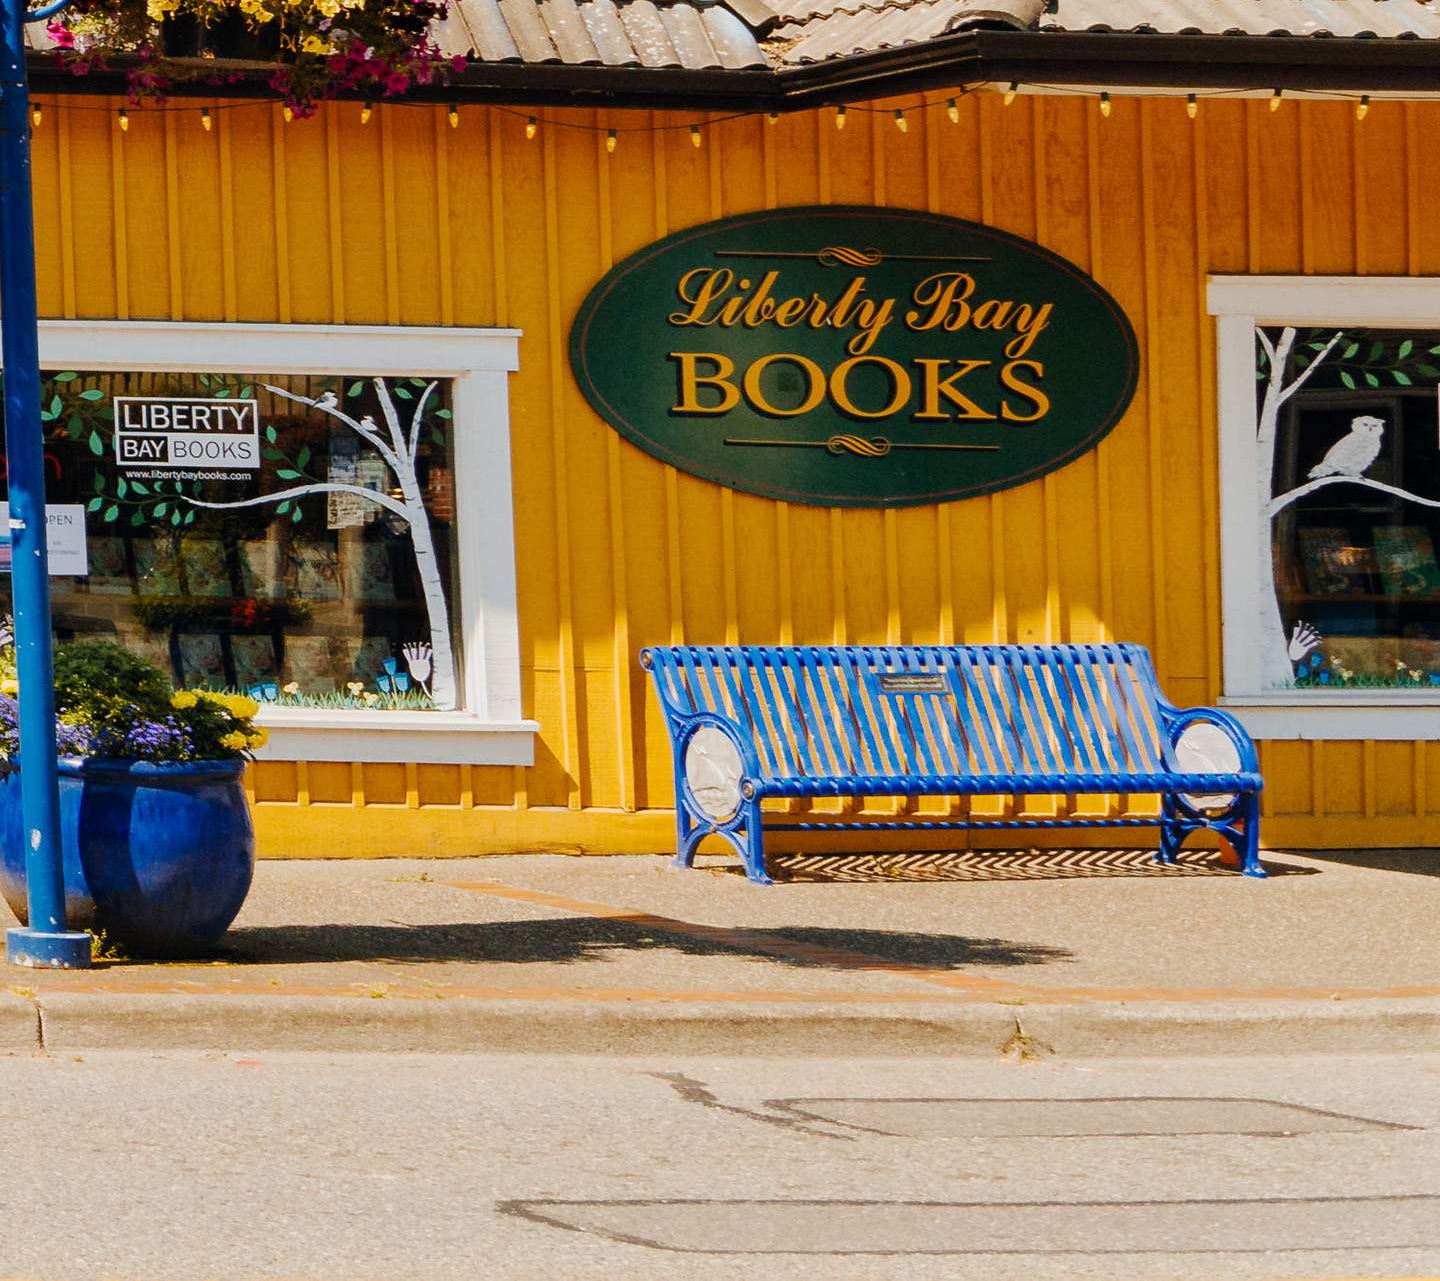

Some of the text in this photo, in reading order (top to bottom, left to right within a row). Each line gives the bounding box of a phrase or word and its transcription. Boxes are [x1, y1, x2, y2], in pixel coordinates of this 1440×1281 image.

[668, 268, 1054, 358] Liberty Bay
[670, 351, 1051, 423] BOOKS
[123, 403, 250, 431] LIBERTY
[123, 439, 252, 460] BAY BOOKS
[125, 469, 252, 482] www.libertybaybooks.com
